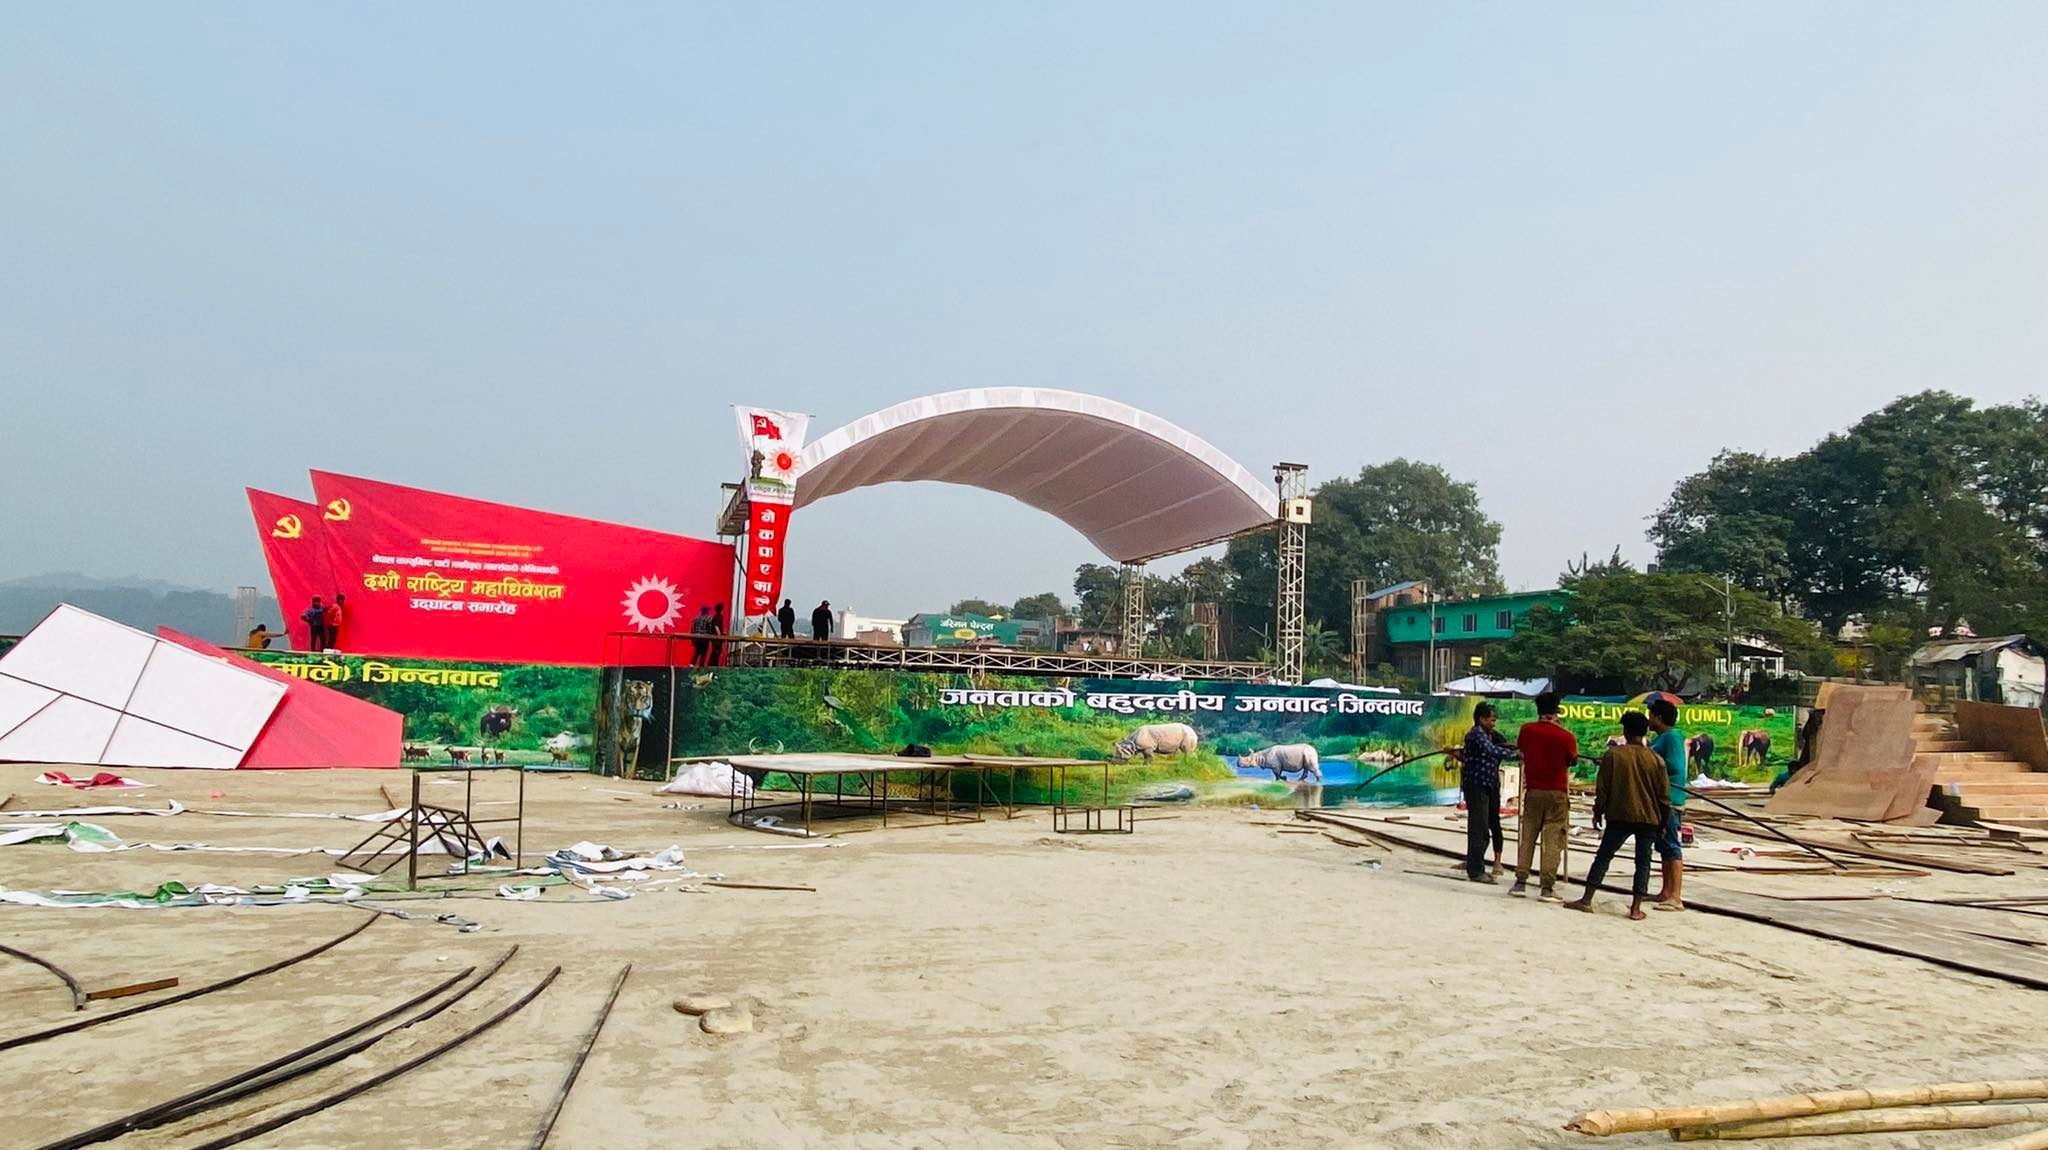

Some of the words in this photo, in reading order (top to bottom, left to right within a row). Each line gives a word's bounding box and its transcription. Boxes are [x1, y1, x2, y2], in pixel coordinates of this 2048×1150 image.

[407, 572, 467, 598] राष्ट्रिय
[471, 577, 564, 599] महाधिवेशन
[467, 602, 518, 615] समारोह
[362, 661, 501, 688] जिन्दावाद
[938, 688, 1077, 708] जनताको
[1087, 690, 1226, 713] बहुदलीय
[1601, 705, 1638, 720] LIV
[1685, 710, 1732, 725] (UML)
